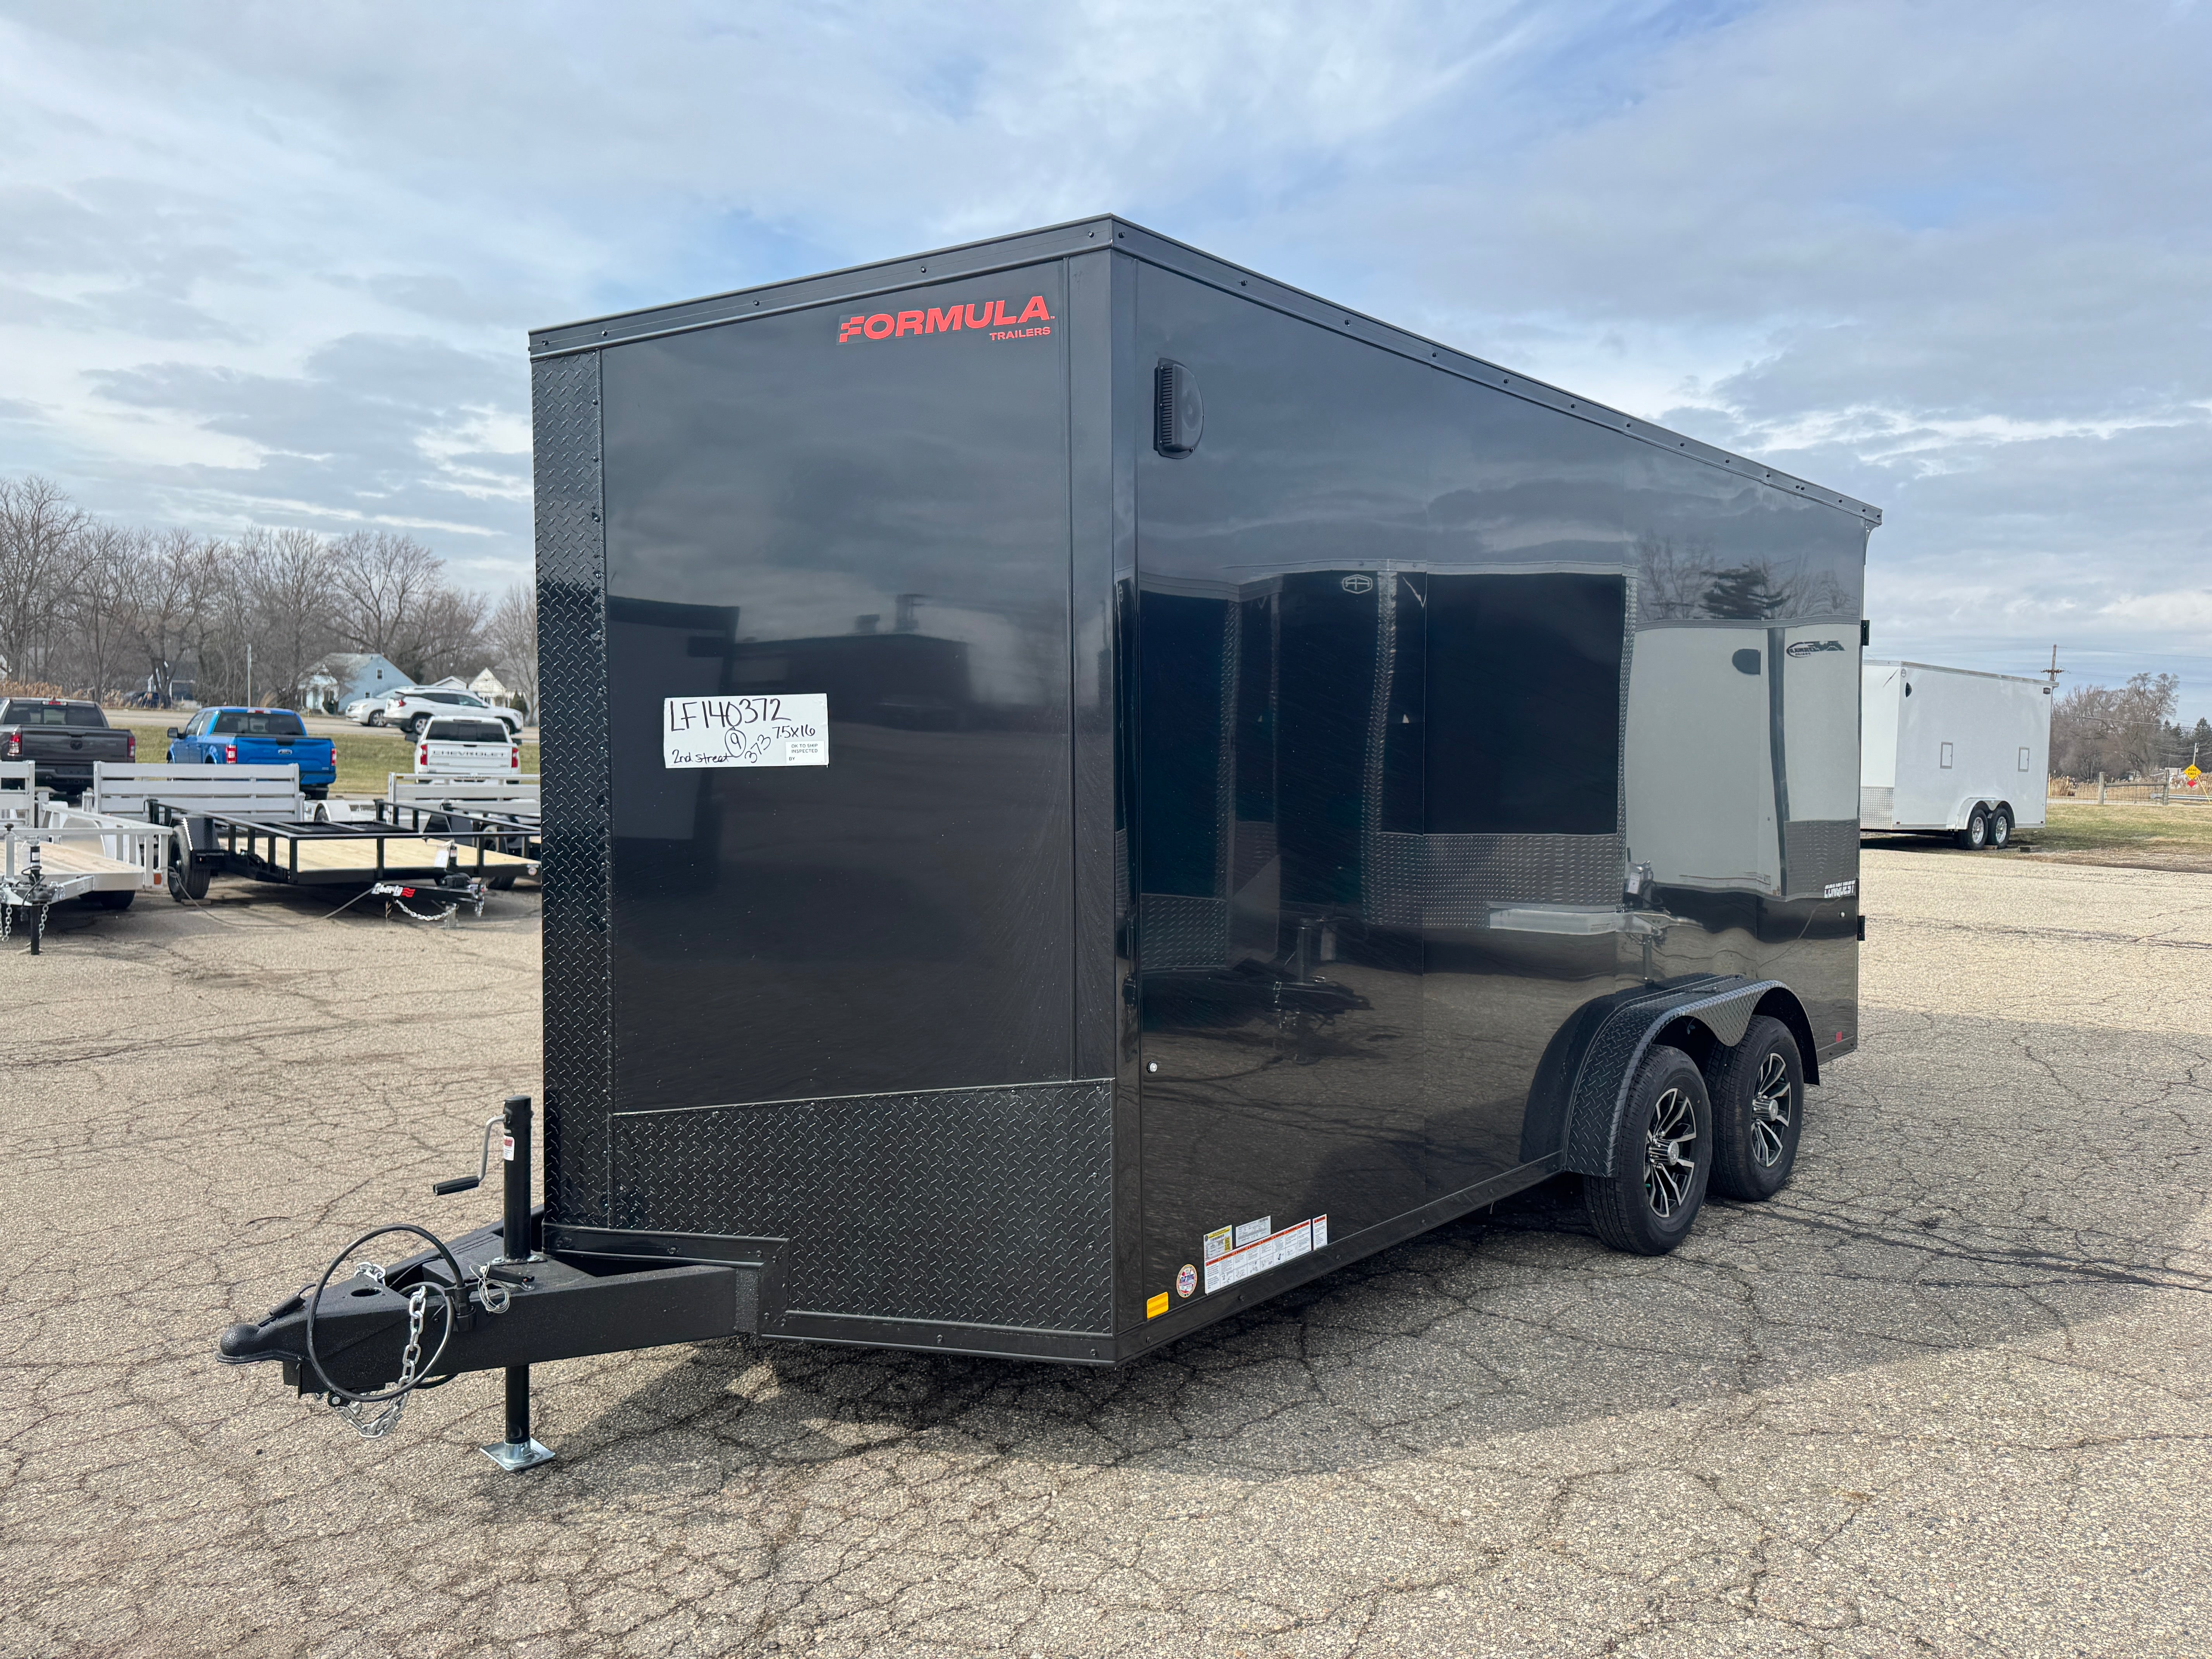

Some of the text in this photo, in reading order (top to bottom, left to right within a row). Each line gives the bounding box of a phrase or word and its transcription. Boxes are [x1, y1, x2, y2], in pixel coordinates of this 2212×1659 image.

[839, 295, 1049, 343] FORMULA
[989, 327, 1050, 341] TRAILERS
[670, 698, 792, 732] LF140372
[672, 749, 693, 763] 2nd
[1824, 880, 1856, 898] CONQUEST
